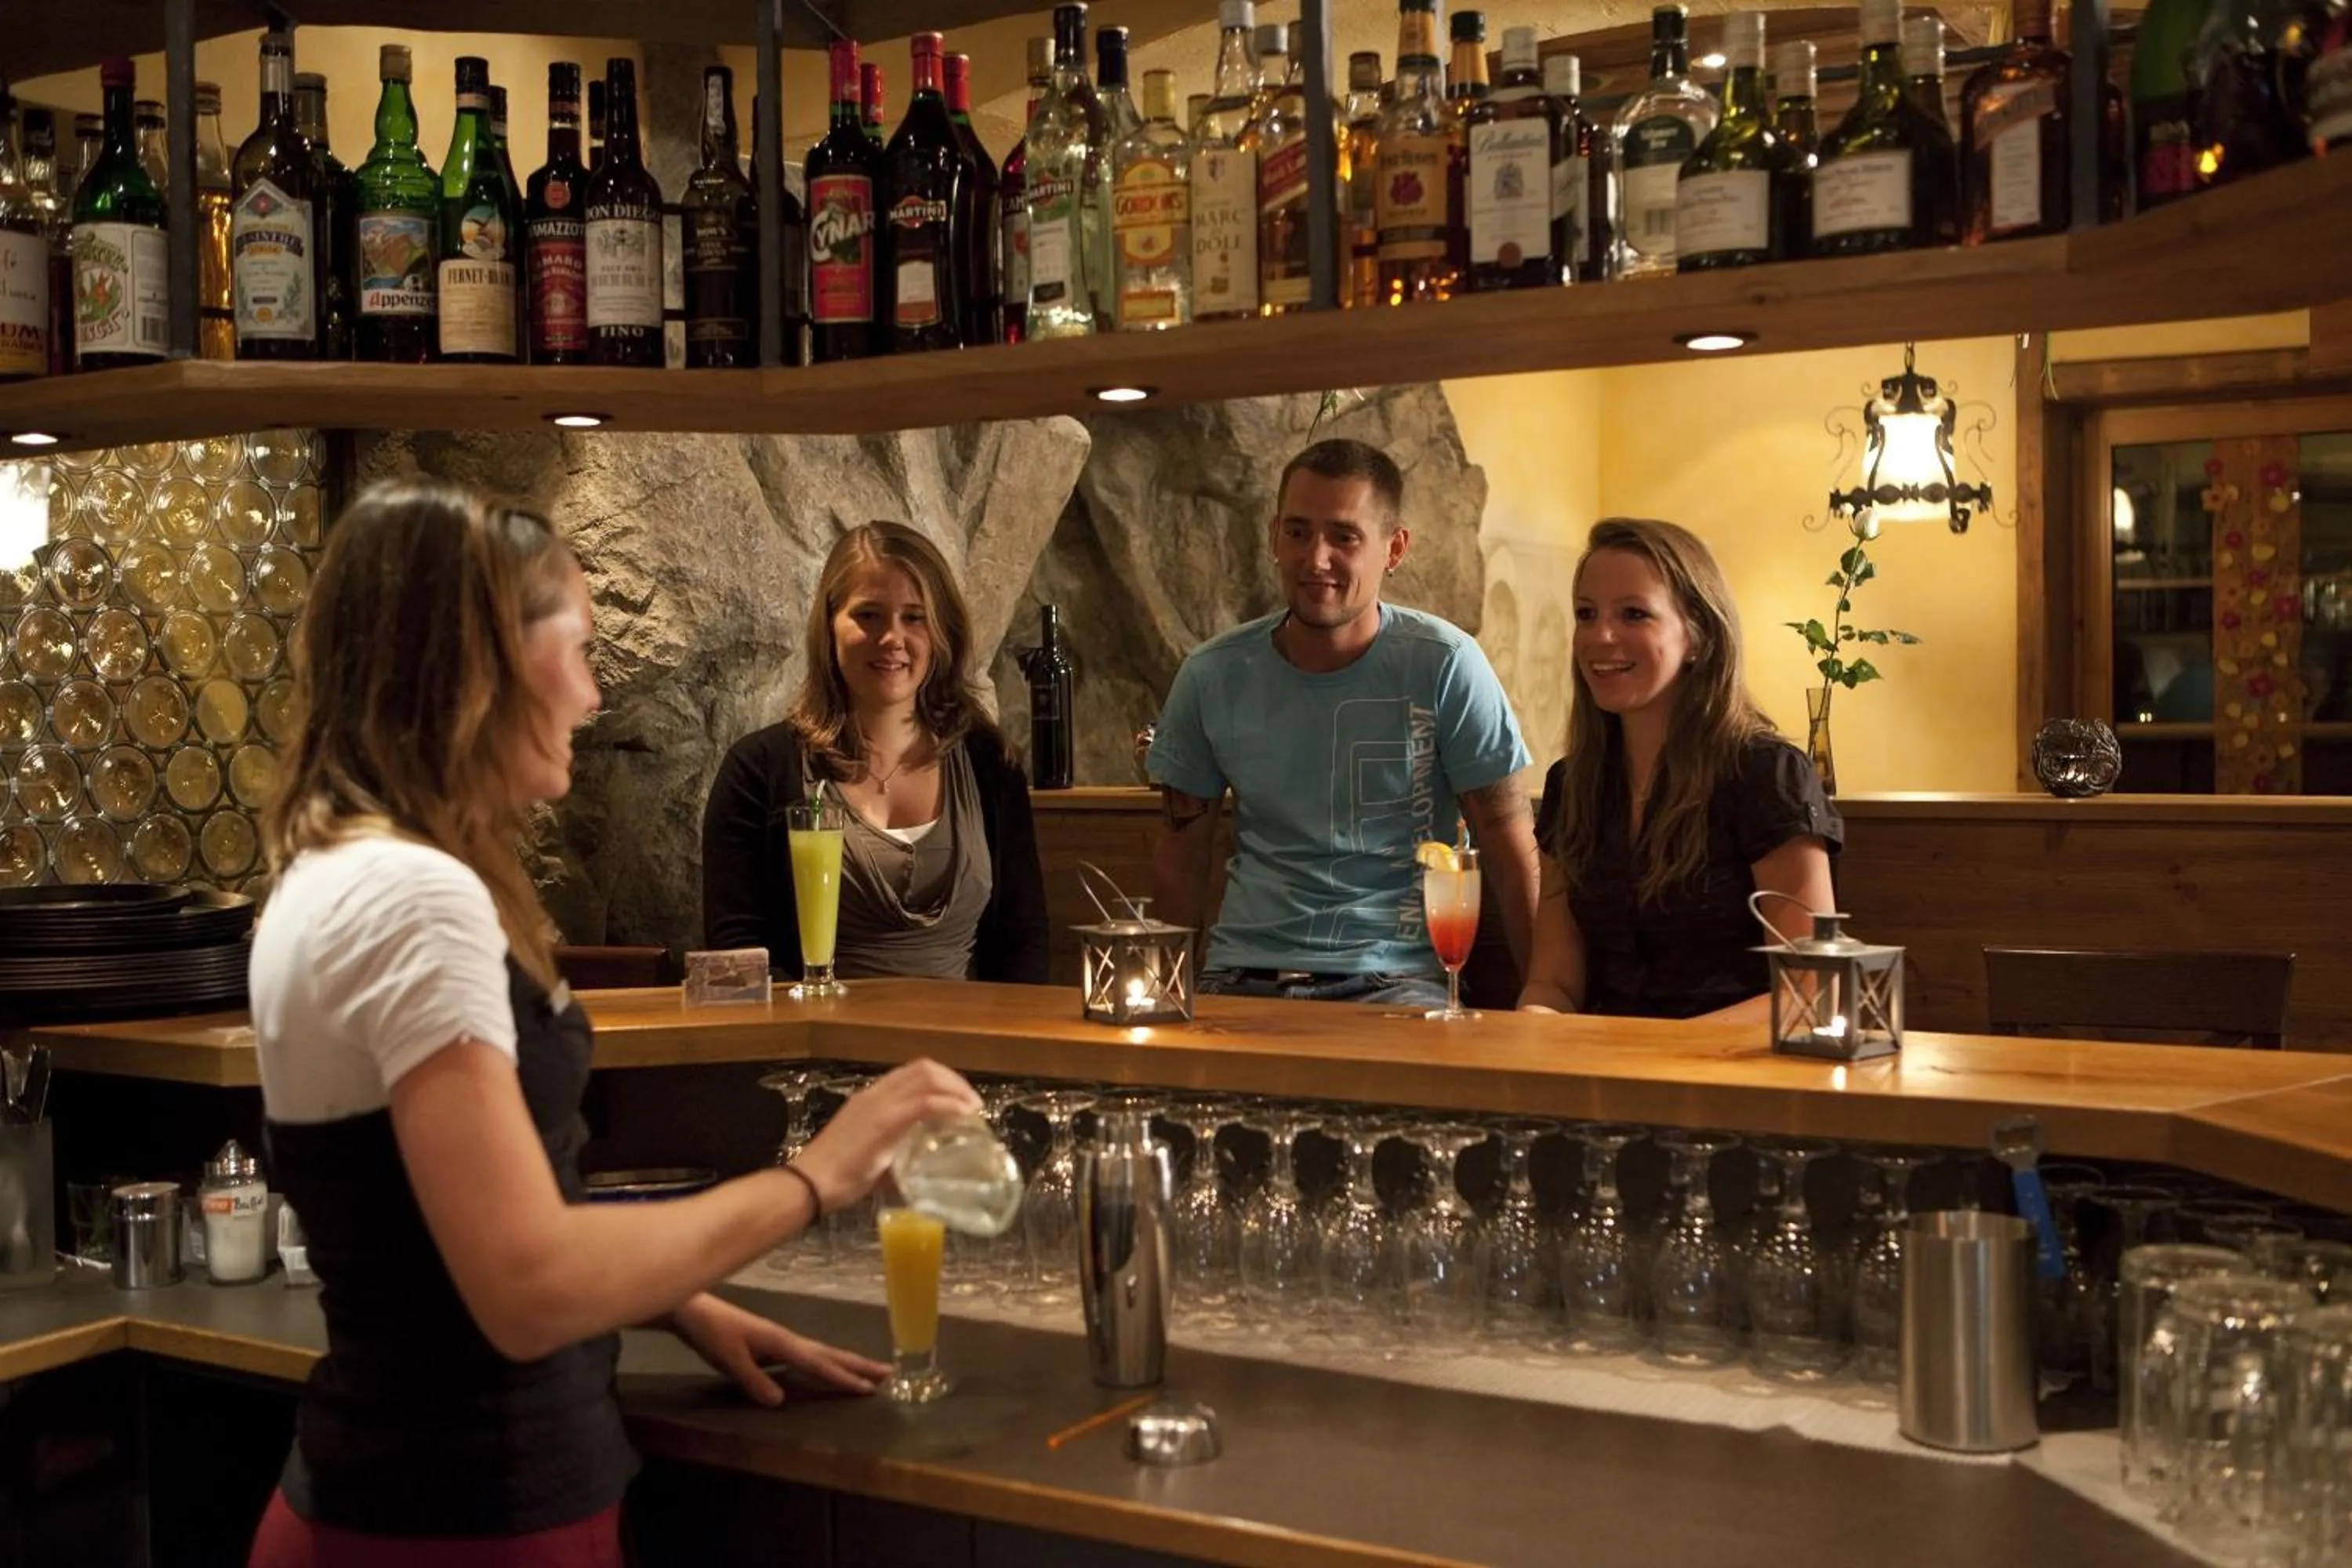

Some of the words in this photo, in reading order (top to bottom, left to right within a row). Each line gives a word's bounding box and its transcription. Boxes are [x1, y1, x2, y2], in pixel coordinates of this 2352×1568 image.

[889, 205, 941, 220] MARTINI
[810, 209, 876, 263] CYNAR
[0, 321, 40, 340] UM
[598, 325, 645, 338] FINO
